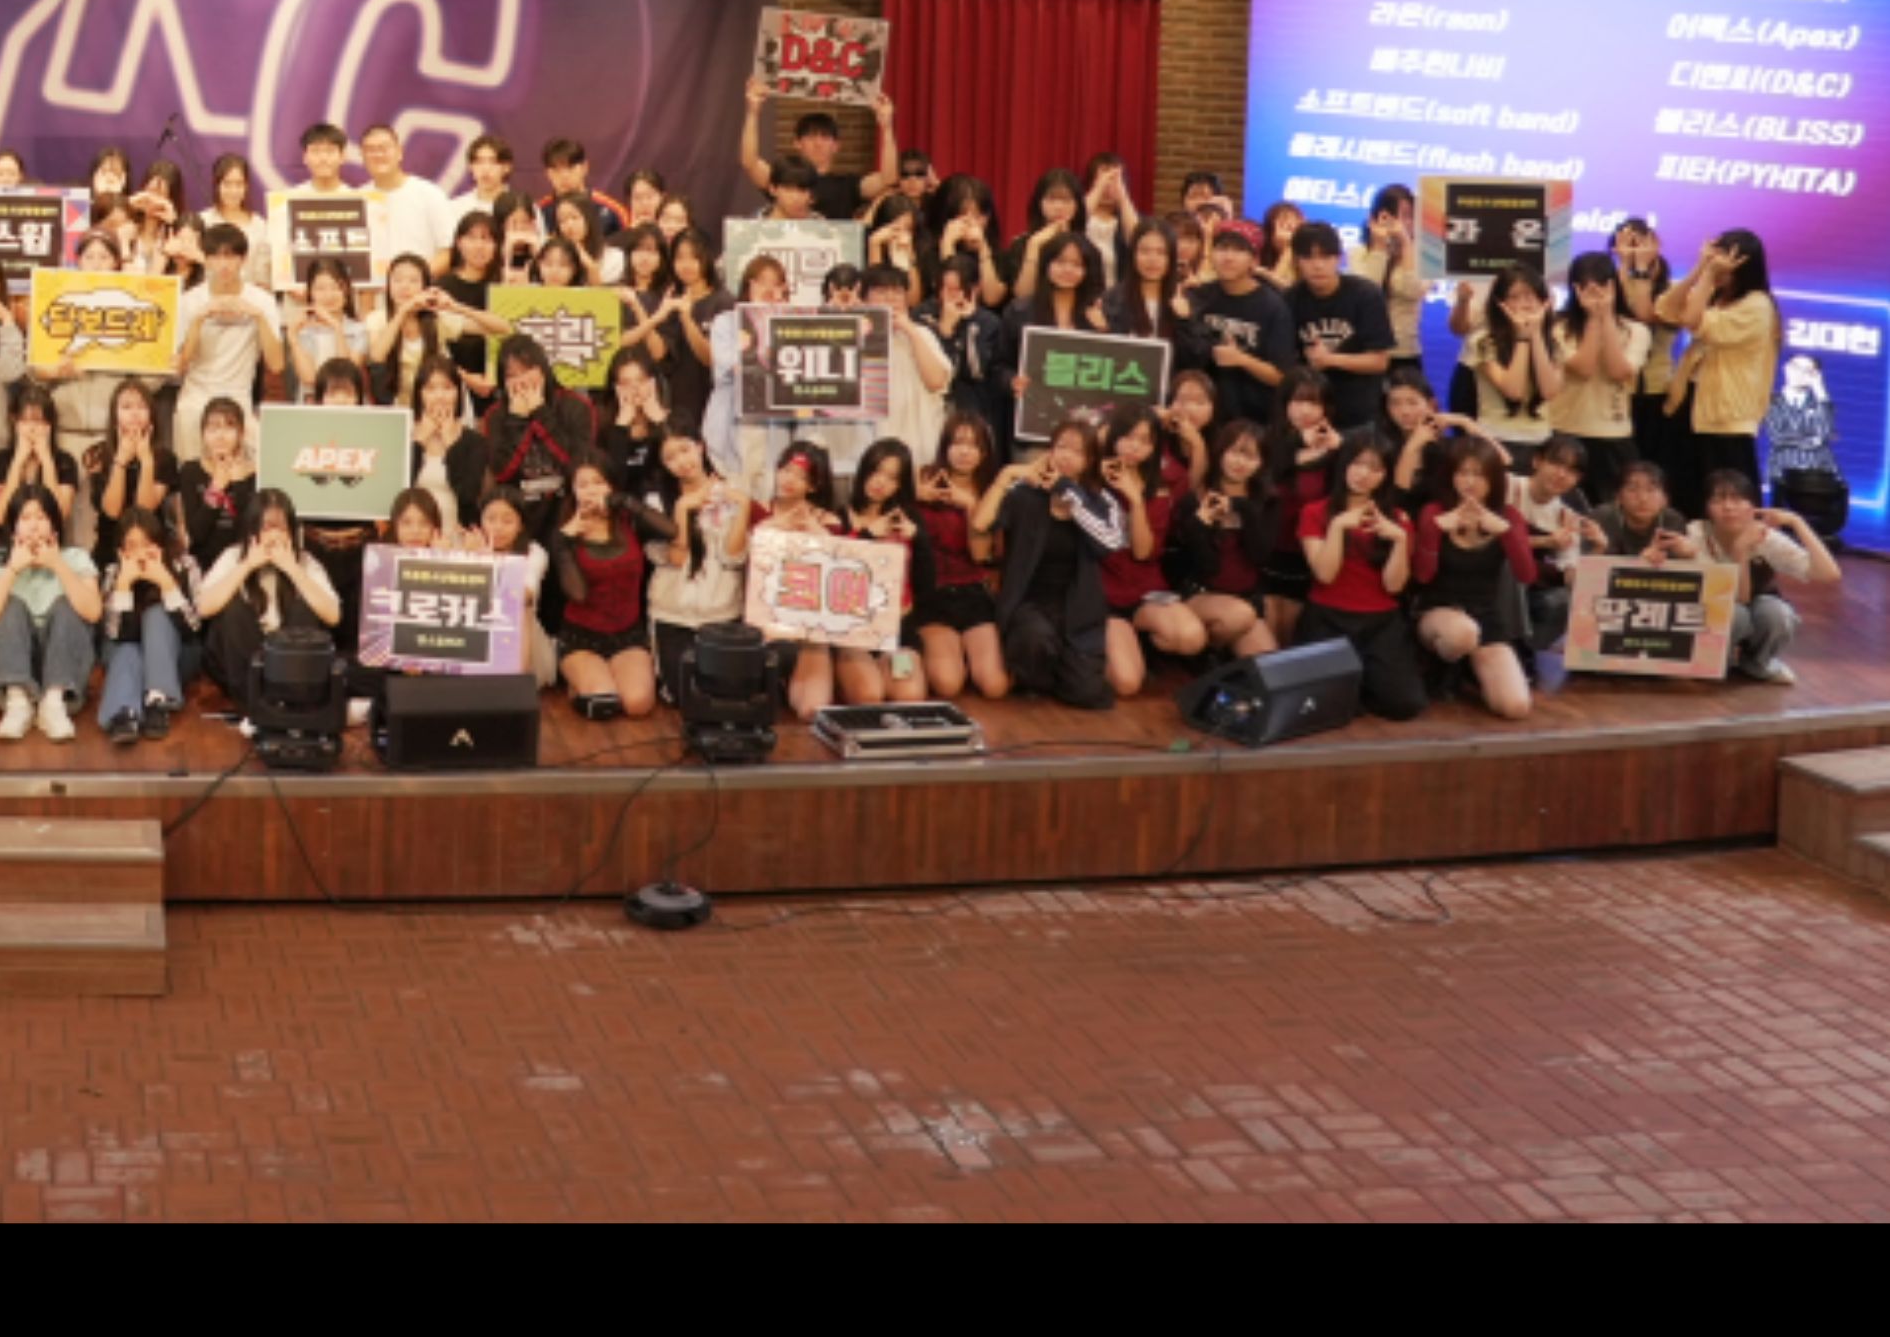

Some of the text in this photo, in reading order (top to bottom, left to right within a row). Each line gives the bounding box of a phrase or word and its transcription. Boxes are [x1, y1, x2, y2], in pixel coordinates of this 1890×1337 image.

[780, 34, 867, 80] D&C
[776, 345, 858, 384] 위니
[1044, 349, 1151, 395] 블리스
[290, 445, 380, 476] APEX
